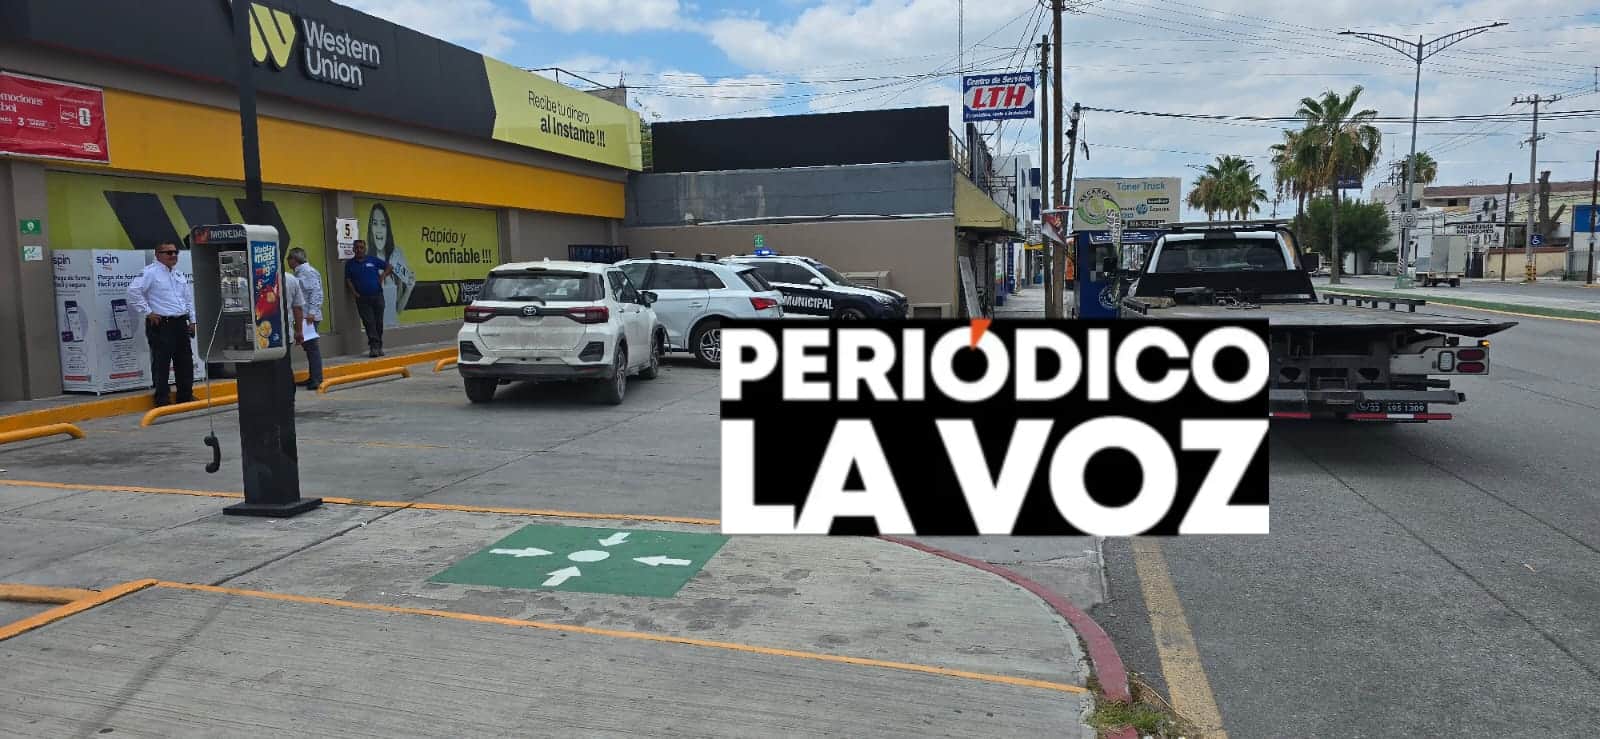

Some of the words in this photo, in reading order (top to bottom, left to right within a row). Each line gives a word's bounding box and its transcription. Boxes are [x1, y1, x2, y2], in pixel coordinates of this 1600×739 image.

[303, 18, 380, 64] Western
[306, 48, 363, 86] Union
[966, 78, 990, 86] Centro
[991, 76, 1001, 84] de
[1002, 74, 1032, 84] Servicio
[972, 85, 1027, 109] LTH
[528, 90, 557, 113] Recibe
[558, 103, 566, 116] tu
[566, 104, 590, 124] dinero
[17, 116, 25, 127] 3
[540, 114, 551, 133] al
[553, 116, 595, 144] Instante
[1116, 182, 1139, 192] Toner
[1143, 181, 1166, 191] Truck
[210, 228, 247, 240] MONEDAS
[344, 223, 351, 237] 5
[421, 225, 458, 247] Rápido
[460, 232, 466, 247] y
[50, 254, 71, 267] spin
[96, 254, 119, 266] spin
[425, 247, 480, 264] Confiable
[784, 295, 834, 310] MUNICIPAL
